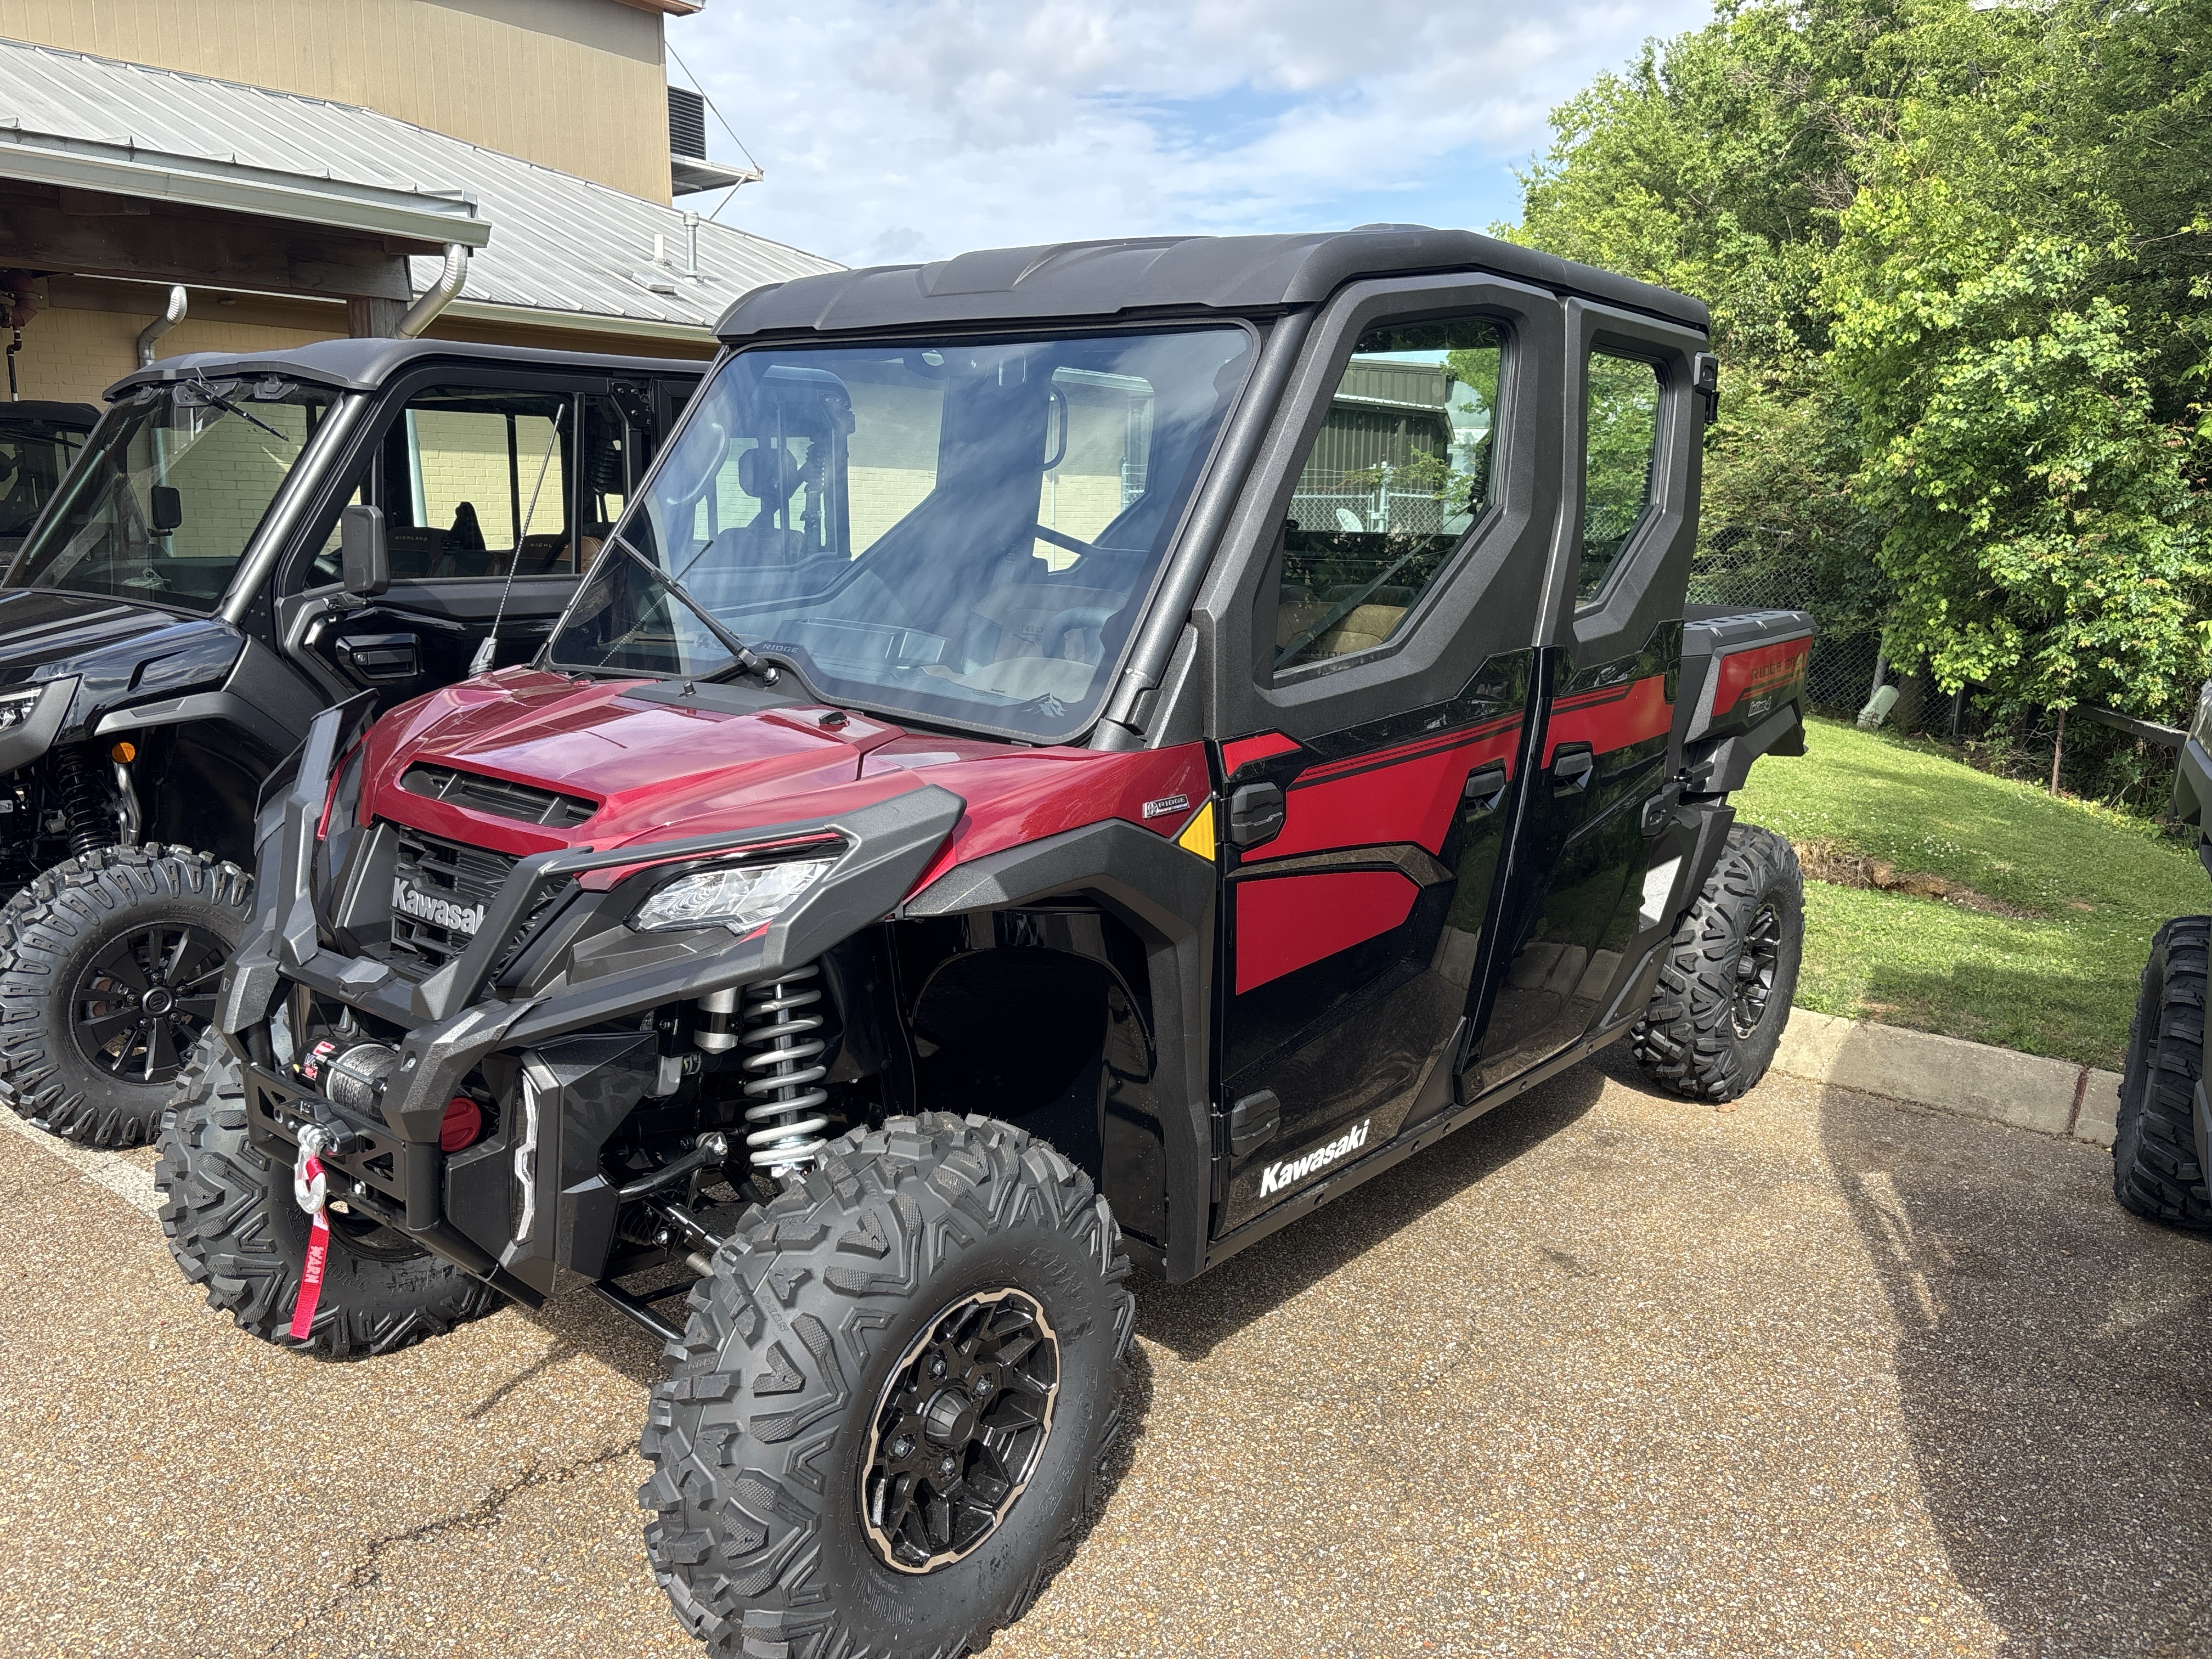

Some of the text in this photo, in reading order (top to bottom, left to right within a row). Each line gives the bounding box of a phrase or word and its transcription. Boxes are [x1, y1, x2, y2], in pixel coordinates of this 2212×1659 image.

[1021, 625, 1044, 633] RID
[762, 643, 799, 653] RIDGE
[1751, 661, 1782, 681] RIDGE
[1159, 797, 1186, 808] RIDGE
[392, 877, 486, 935] Kawasak
[1259, 1118, 1370, 1198] Kawasaki
[304, 1245, 324, 1284] WARN
